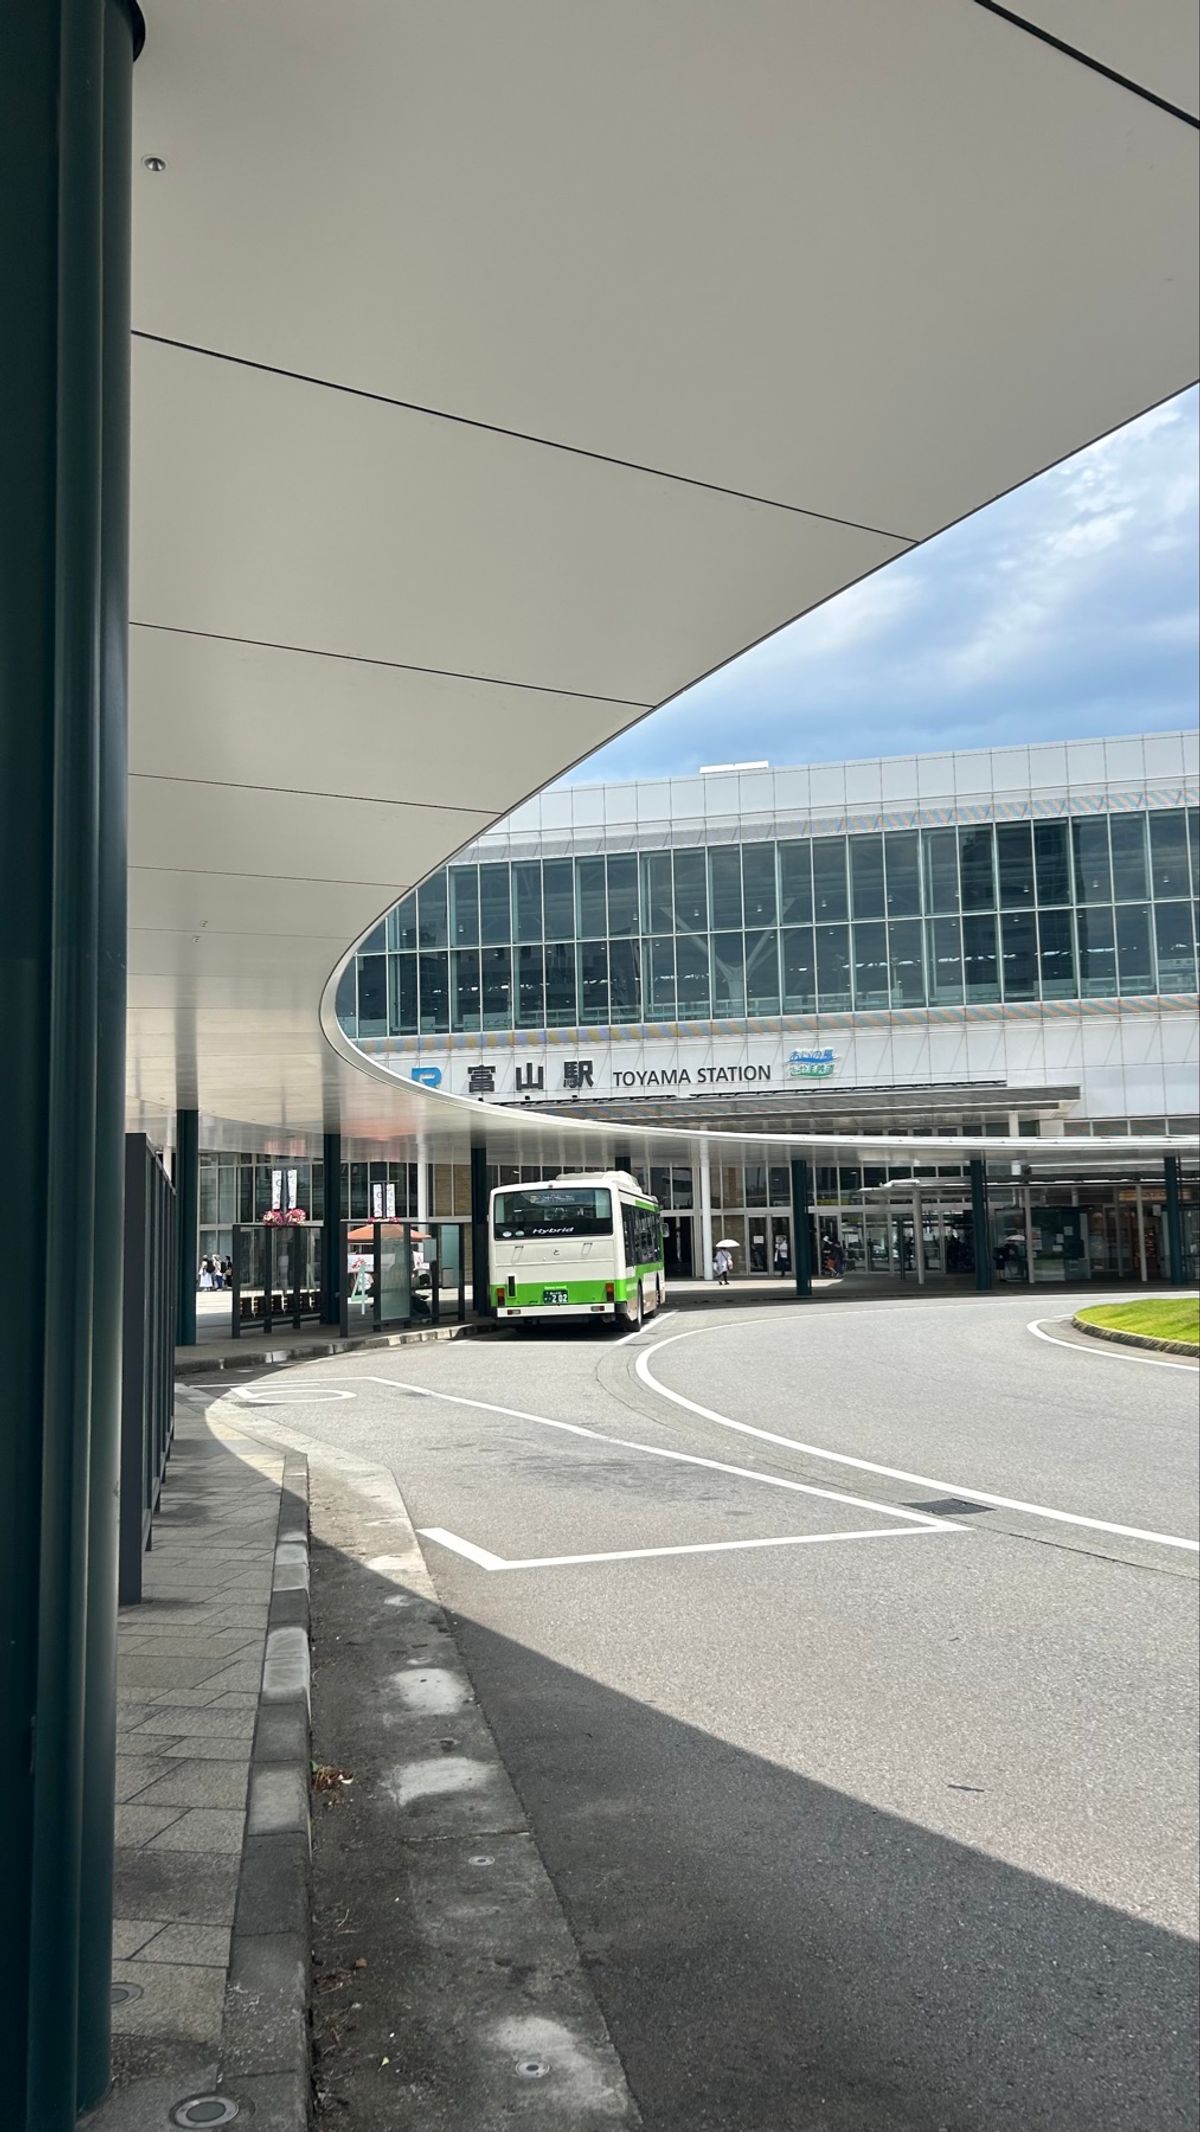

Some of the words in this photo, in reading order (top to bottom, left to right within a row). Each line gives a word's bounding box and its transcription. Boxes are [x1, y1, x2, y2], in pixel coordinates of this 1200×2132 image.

[467, 1060, 594, 1093] 富山駅
[613, 1069, 691, 1087] TOYAMA
[697, 1065, 771, 1083] STATION
[532, 1226, 575, 1235] Hybrid
